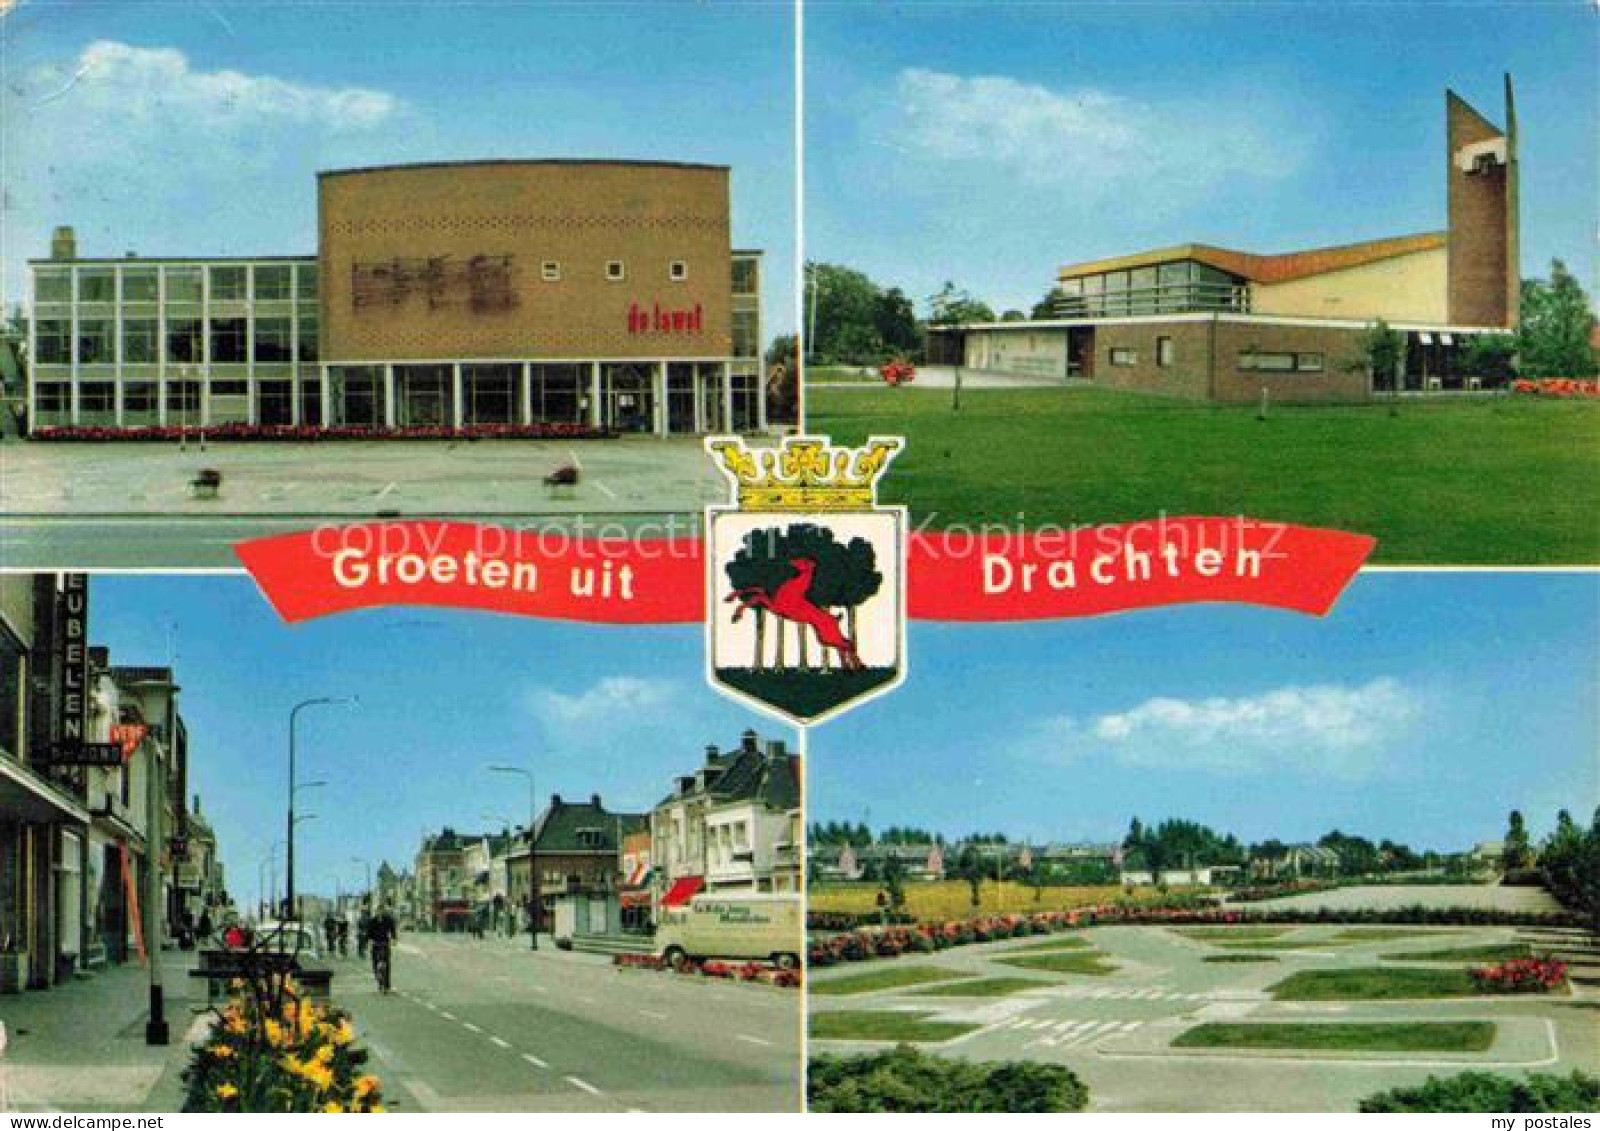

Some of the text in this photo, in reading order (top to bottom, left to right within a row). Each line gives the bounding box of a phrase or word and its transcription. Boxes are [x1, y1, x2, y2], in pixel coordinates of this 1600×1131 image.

[333, 541, 1261, 600] Groeten uit Drachten
